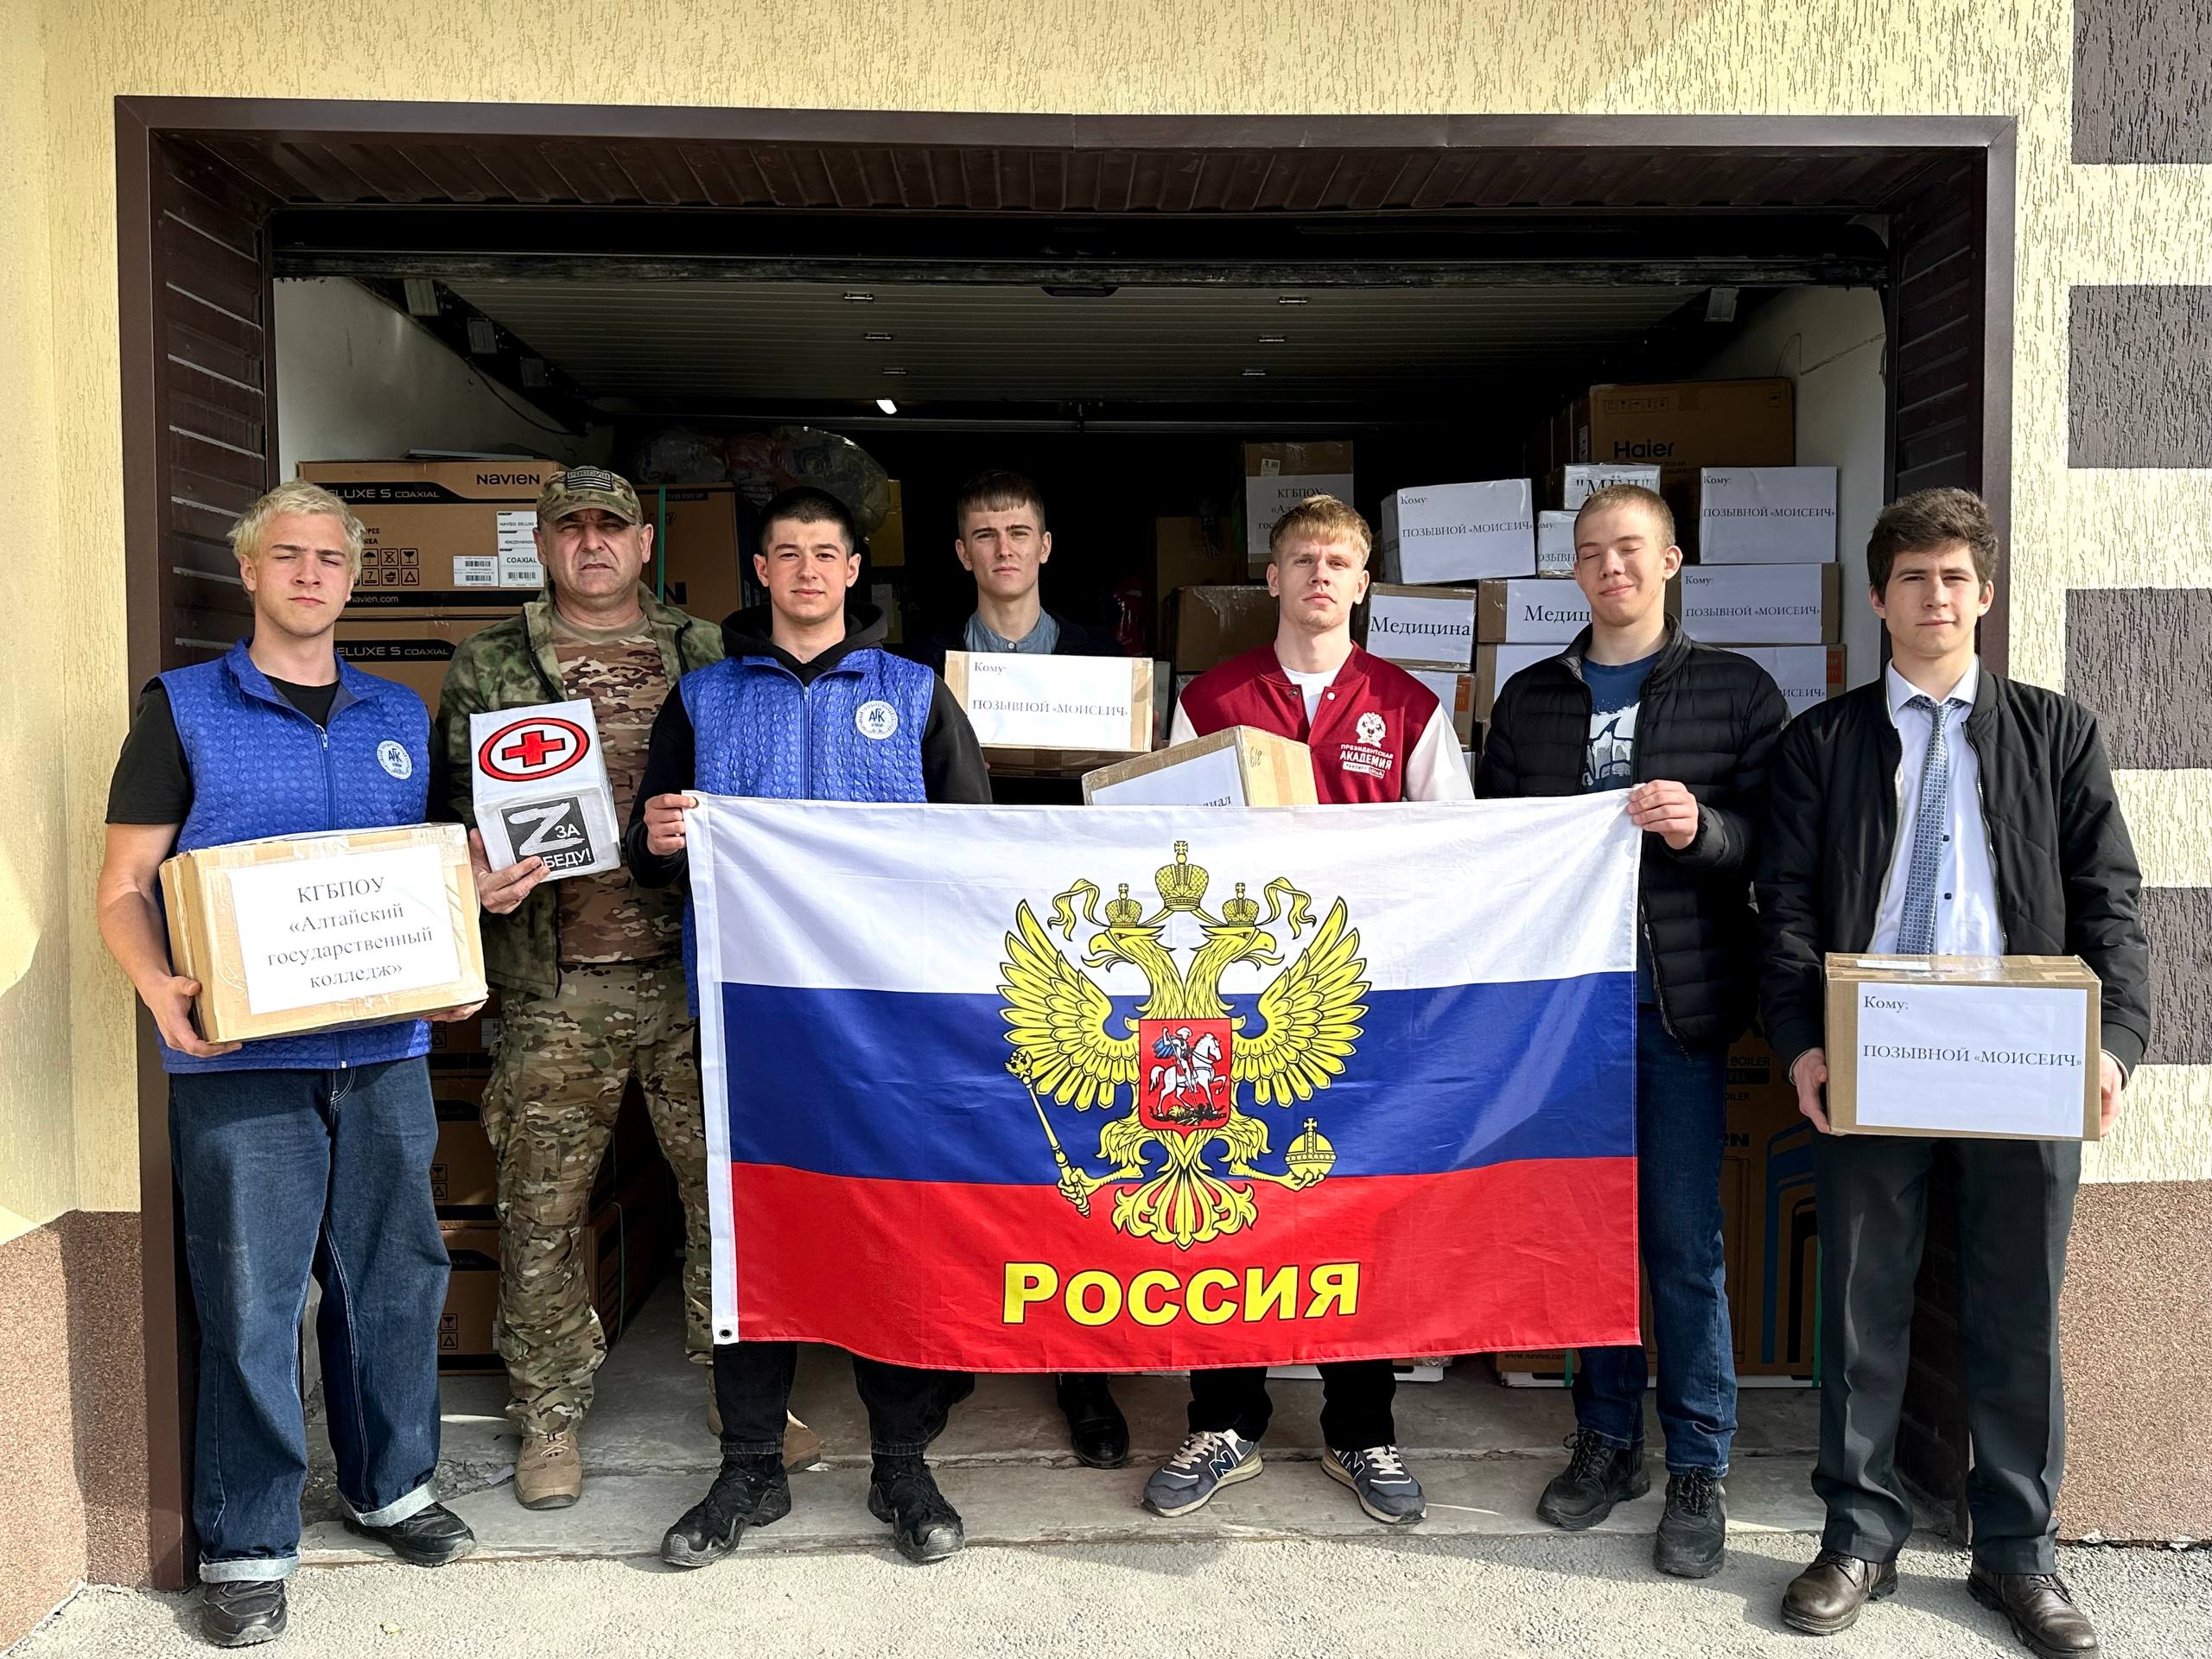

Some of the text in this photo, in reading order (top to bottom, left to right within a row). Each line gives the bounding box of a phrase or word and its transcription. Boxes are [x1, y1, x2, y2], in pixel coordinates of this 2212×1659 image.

[1613, 439, 1675, 459] Haier
[380, 488, 391, 499] S
[1704, 505, 1768, 518] ПОЗЫВНОЙ
[1402, 524, 1466, 537] ПОЗЫВНОЙ
[1523, 605, 1591, 623] Медиц
[1686, 605, 1751, 617] ПОЗЫВНОЙ
[1370, 616, 1471, 636] Медицина
[337, 646, 385, 657] ELUXE
[390, 646, 401, 656] S
[1782, 689, 1825, 698] ИСЕИЧ»
[972, 699, 1050, 713] ПОЗЫВНОЙ
[1339, 750, 1393, 771] АКАДЕМИЯ
[554, 823, 581, 839] ЗА
[540, 849, 593, 868] БЕДУ!
[297, 876, 385, 904] КГБПОУ
[289, 903, 404, 933] «Алтайский
[267, 927, 433, 967] государственный
[309, 963, 403, 988] колледж»
[1863, 995, 1909, 1013] Кому:
[1731, 1056, 1770, 1066] BOILER
[1863, 1044, 2082, 1067] ПОЗЫВНОЙ «МОИСЕИЧ»
